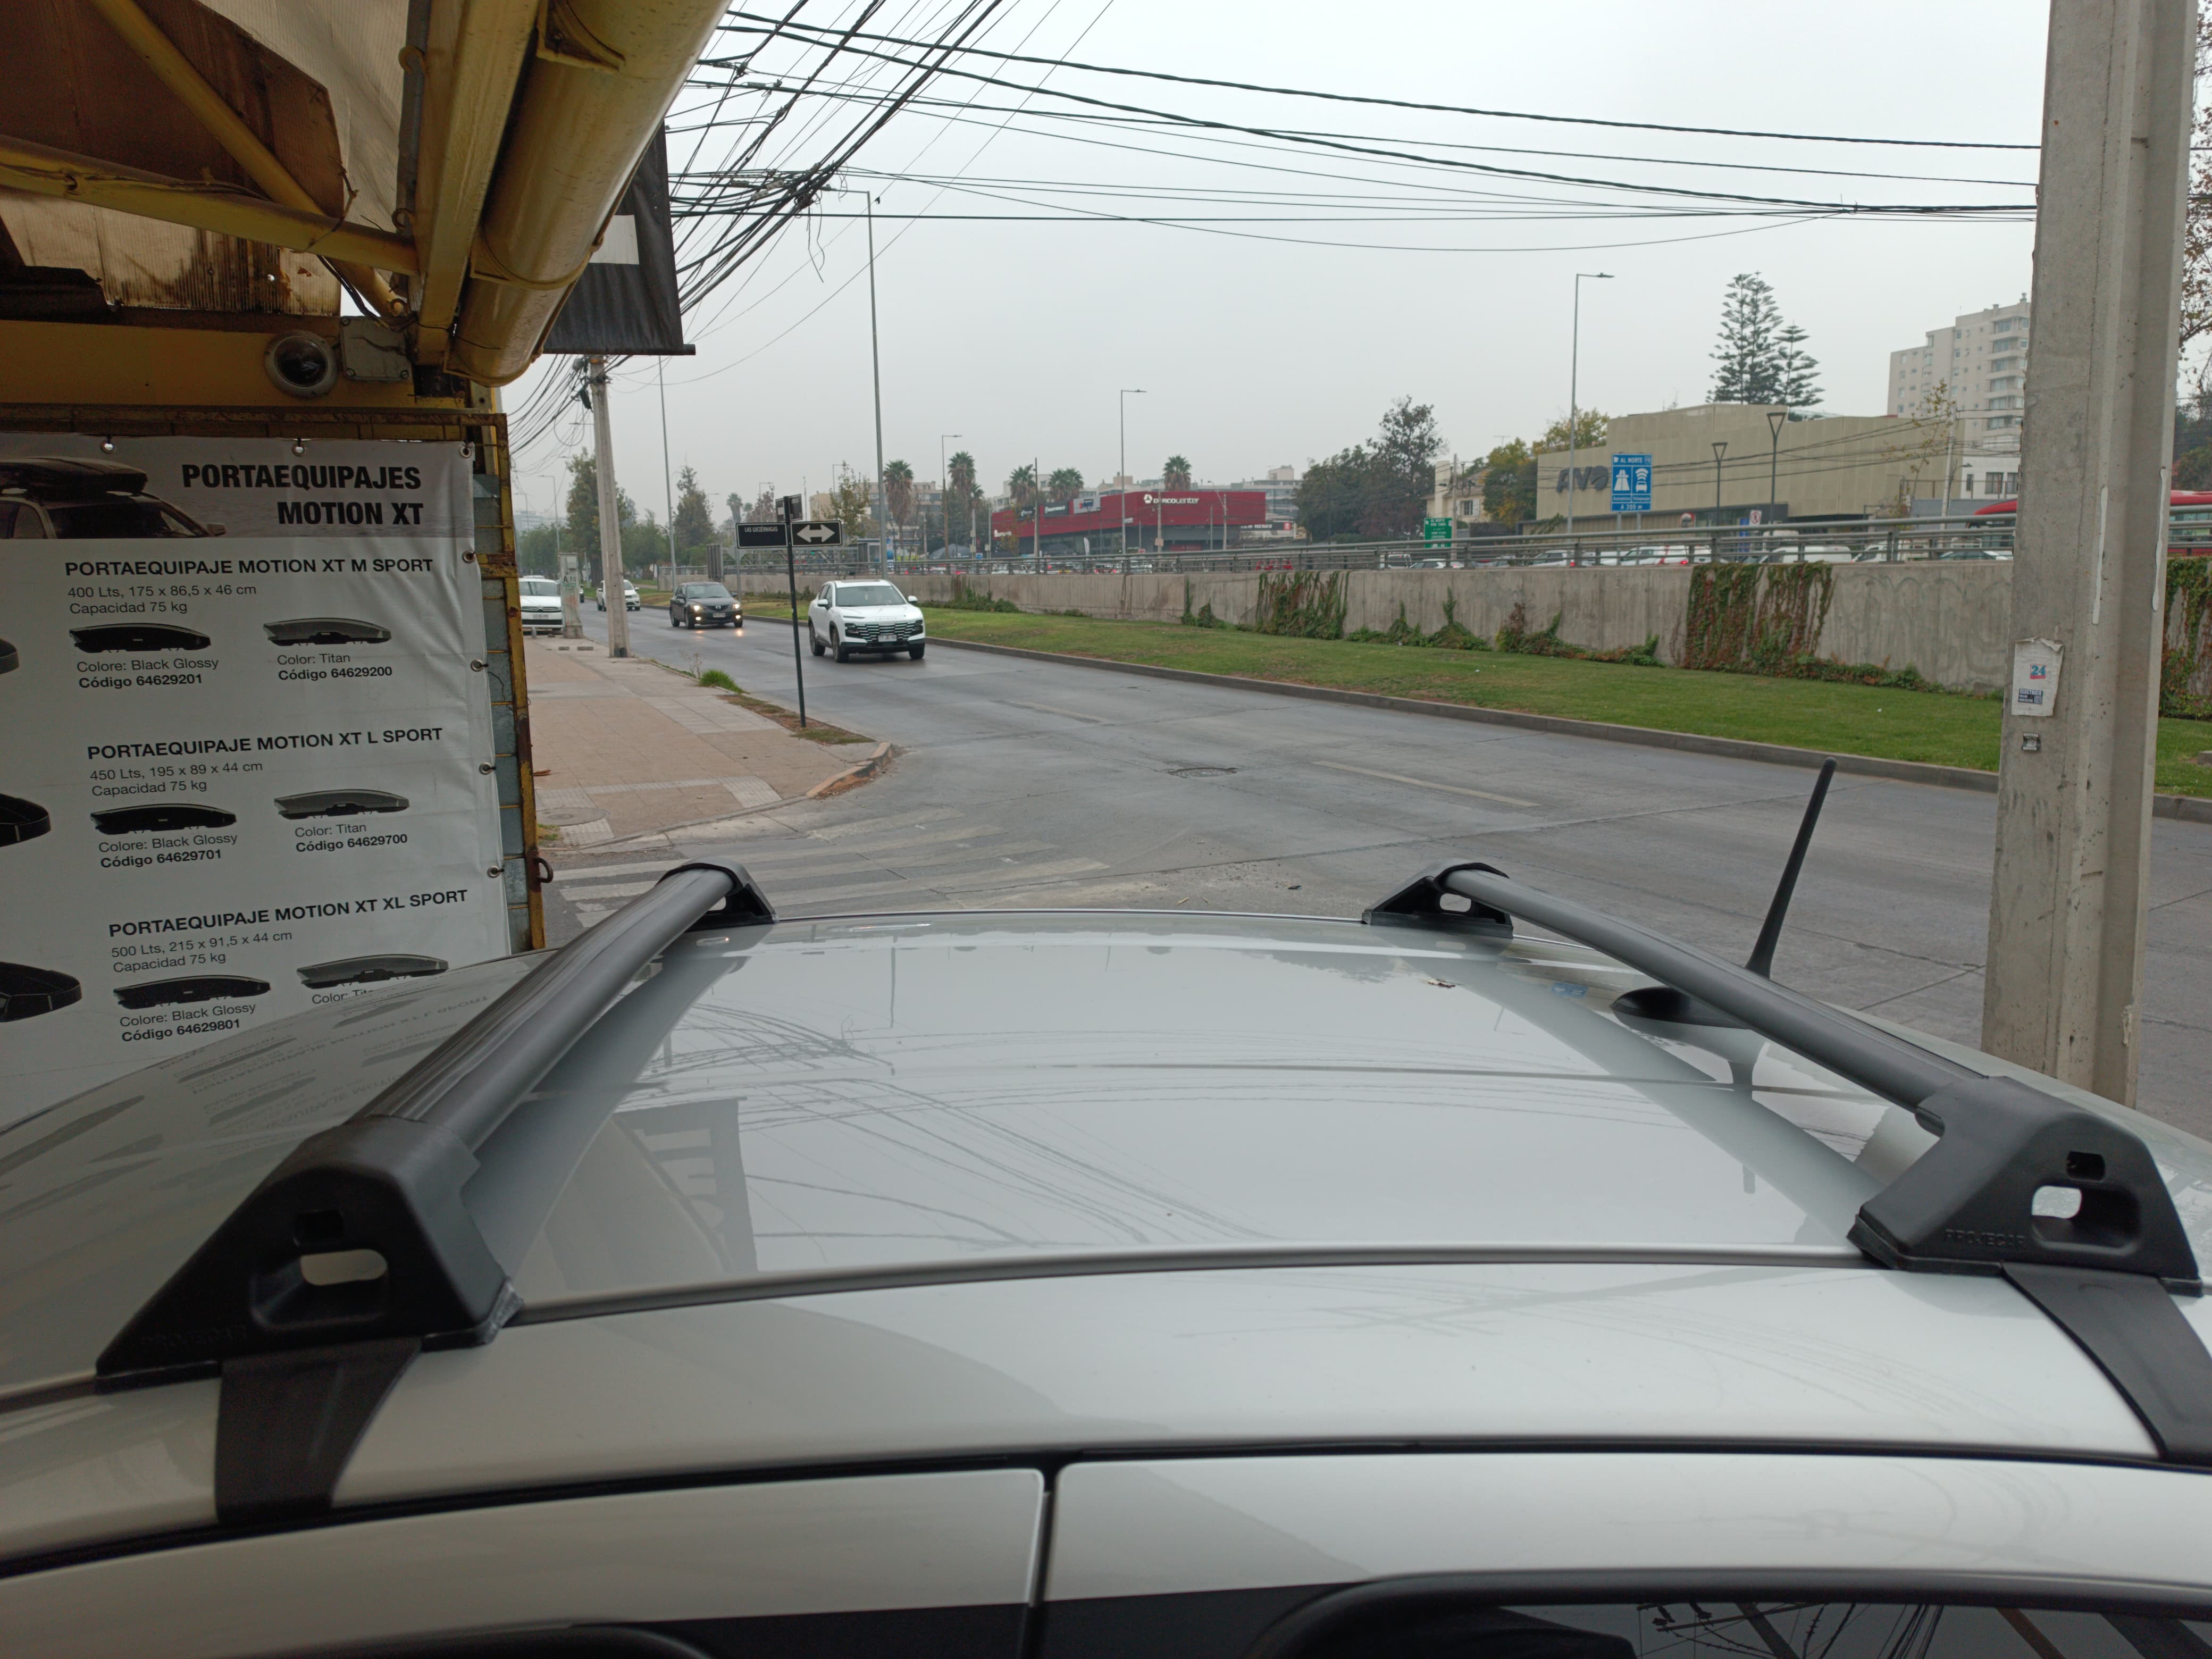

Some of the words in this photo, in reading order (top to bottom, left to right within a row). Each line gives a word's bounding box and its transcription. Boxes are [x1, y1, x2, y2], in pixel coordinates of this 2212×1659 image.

[181, 464, 421, 489] PORTAEQUIPAJES
[277, 501, 383, 525] MOTION
[391, 502, 424, 525] XT
[65, 560, 233, 576] PORTAEQUIPAJE
[238, 559, 316, 574] MOTION
[321, 559, 346, 572] XT
[351, 559, 367, 572] M
[372, 558, 433, 572] SPORT
[68, 586, 94, 598] 400
[98, 586, 124, 598] Lts,
[129, 586, 154, 597] 175
[170, 585, 199, 597] 86,5
[215, 584, 232, 595] 46
[70, 602, 145, 616] Capacidad
[149, 601, 166, 612] 75
[171, 601, 187, 614] kg
[77, 661, 127, 673] Colore:
[131, 659, 170, 671] Black
[173, 658, 219, 670] Glossy
[277, 655, 315, 665] Color:
[319, 653, 350, 663] Titan
[278, 669, 327, 681] Código
[331, 666, 392, 678] 64629200
[2031, 665, 2046, 676] 24
[79, 676, 132, 689] Código
[136, 674, 202, 686] 64629201
[87, 738, 252, 760] PORTAEQUIPAJE
[257, 733, 333, 750] MOTION
[339, 732, 362, 745] XT
[367, 731, 379, 744] L
[383, 727, 443, 743] SPORT
[90, 769, 115, 781] 450
[120, 769, 145, 779] Lts,
[149, 766, 174, 777] 195
[190, 764, 206, 775] 89
[222, 763, 239, 773] 44
[242, 763, 263, 772] cm
[91, 782, 166, 798] Capacidad
[170, 781, 187, 791] 75
[191, 780, 207, 792] kg
[295, 826, 332, 837] Color:
[336, 824, 366, 834] Titan
[98, 841, 147, 853] Colore:
[152, 836, 190, 849] Black
[193, 835, 238, 845] Glossy
[296, 840, 343, 852] Código
[347, 834, 407, 848] 64629700
[100, 856, 153, 868] Código
[156, 849, 221, 864] 64629701
[108, 910, 270, 938] PORTAEQUIPAJE
[275, 902, 349, 921] MOTION
[355, 899, 378, 914] XT
[382, 896, 405, 910] XL
[409, 889, 467, 907] SPORT
[112, 945, 137, 958] 500
[140, 944, 165, 955] Lts,
[169, 940, 194, 952] 215
[209, 935, 238, 948] 91,5
[253, 933, 269, 943] 44
[273, 932, 292, 941] cm
[113, 956, 186, 973] Capacidad
[189, 953, 206, 965] 75
[210, 952, 226, 964] kg
[120, 1015, 167, 1027] Colore:
[172, 1008, 209, 1021] Black
[212, 1004, 256, 1016] Glossy
[122, 1029, 173, 1042] Código
[177, 1019, 239, 1035] 64629801
